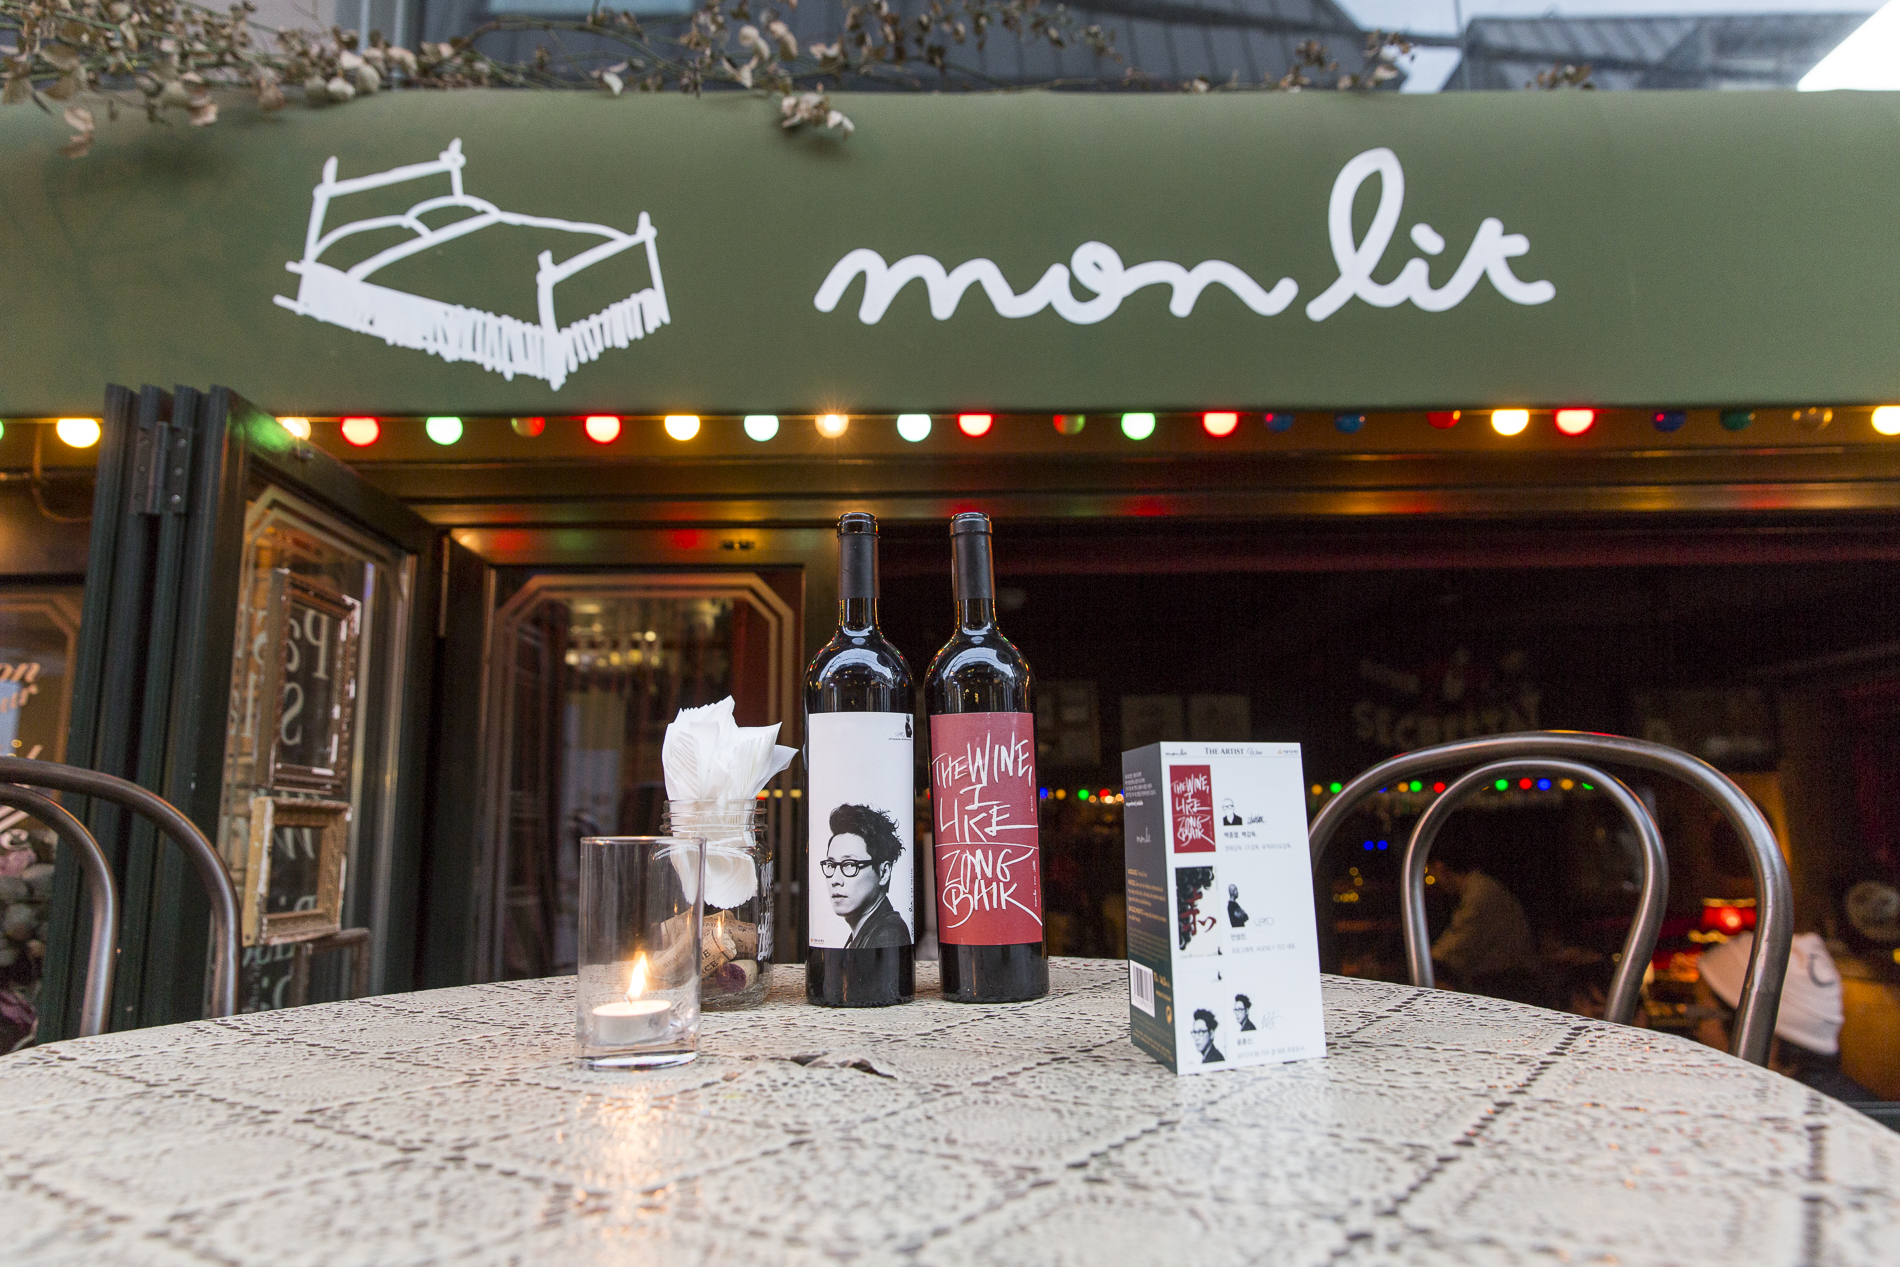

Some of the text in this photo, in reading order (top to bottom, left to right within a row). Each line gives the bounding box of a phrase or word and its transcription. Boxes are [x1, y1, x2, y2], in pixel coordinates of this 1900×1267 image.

[932, 752, 968, 788] THE
[1204, 747, 1218, 755] THE
[959, 783, 1003, 811] I
[940, 797, 1039, 844] LIKE
[941, 848, 1035, 893] ZONG
[942, 879, 1043, 929] BAIK
